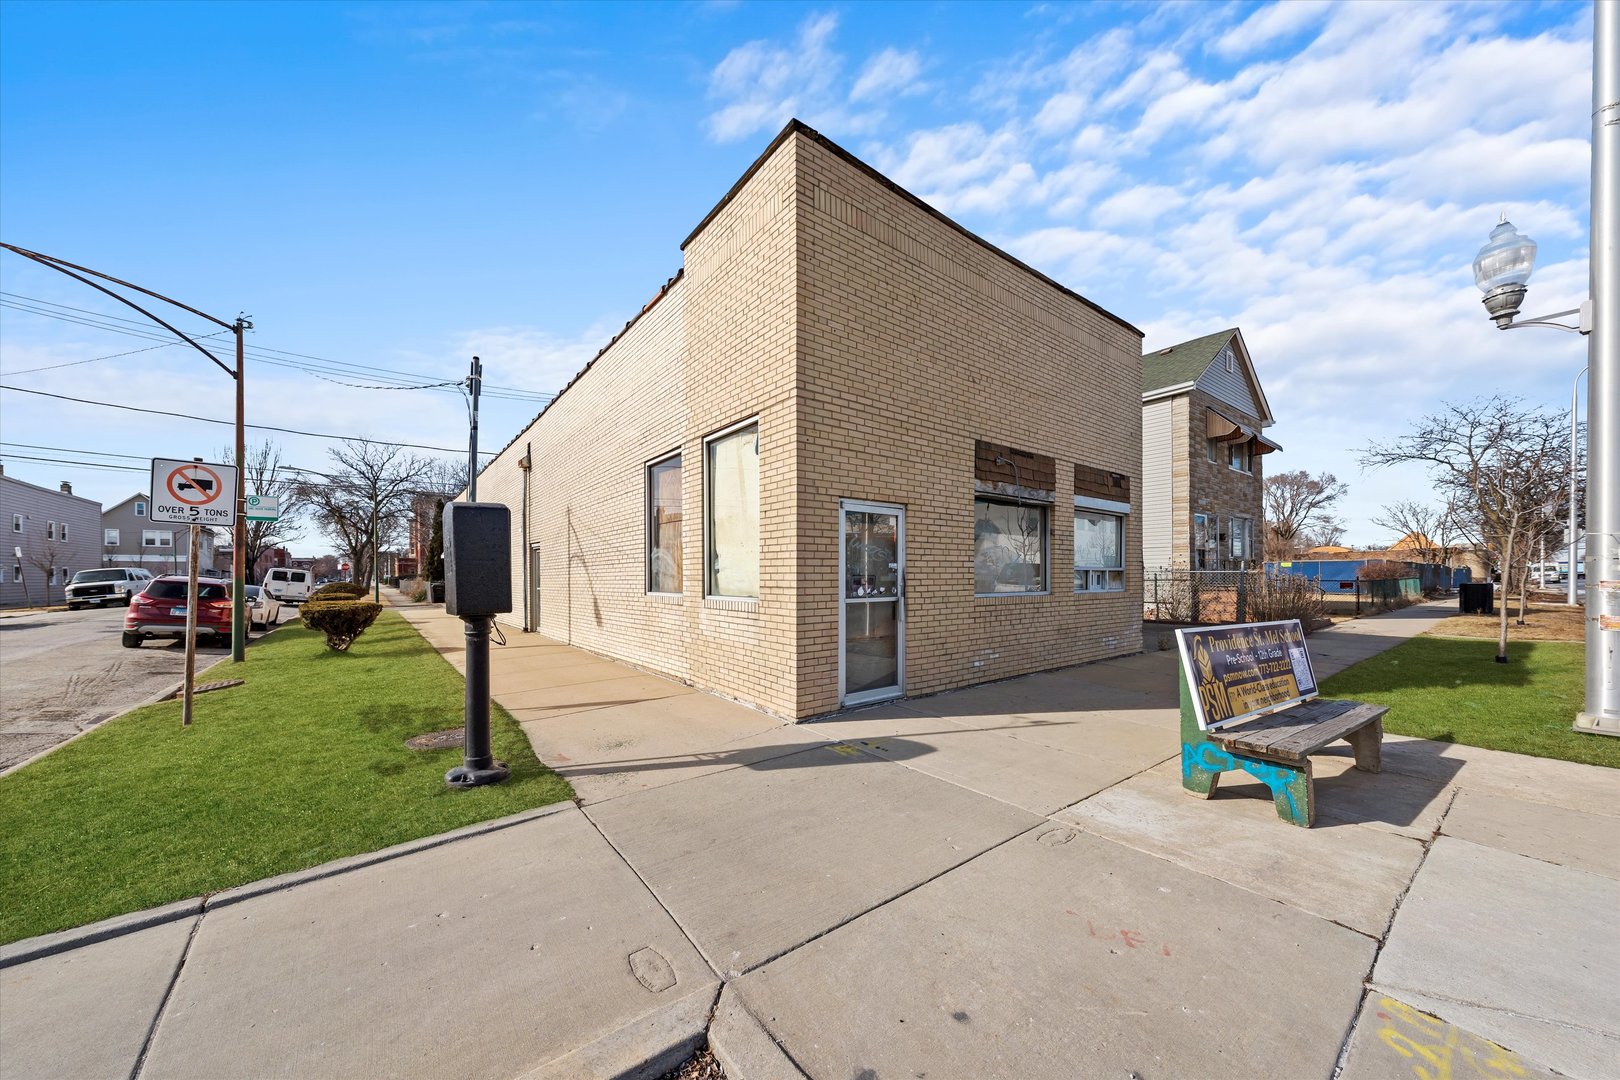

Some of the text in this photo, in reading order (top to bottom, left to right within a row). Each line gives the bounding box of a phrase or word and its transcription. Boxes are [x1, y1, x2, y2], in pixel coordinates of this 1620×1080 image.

[158, 505, 229, 517] OVER 5 TONS
[1208, 627, 1301, 653] Providence St. Mel School
[1226, 651, 1255, 665] Pre-School
[1258, 649, 1269, 661] 12th
[1268, 648, 1283, 659] Grade
[1259, 659, 1292, 675] 773-722-2222
[1236, 688, 1242, 698] A
[1269, 677, 1290, 691] education
[1199, 679, 1233, 723] PSM
